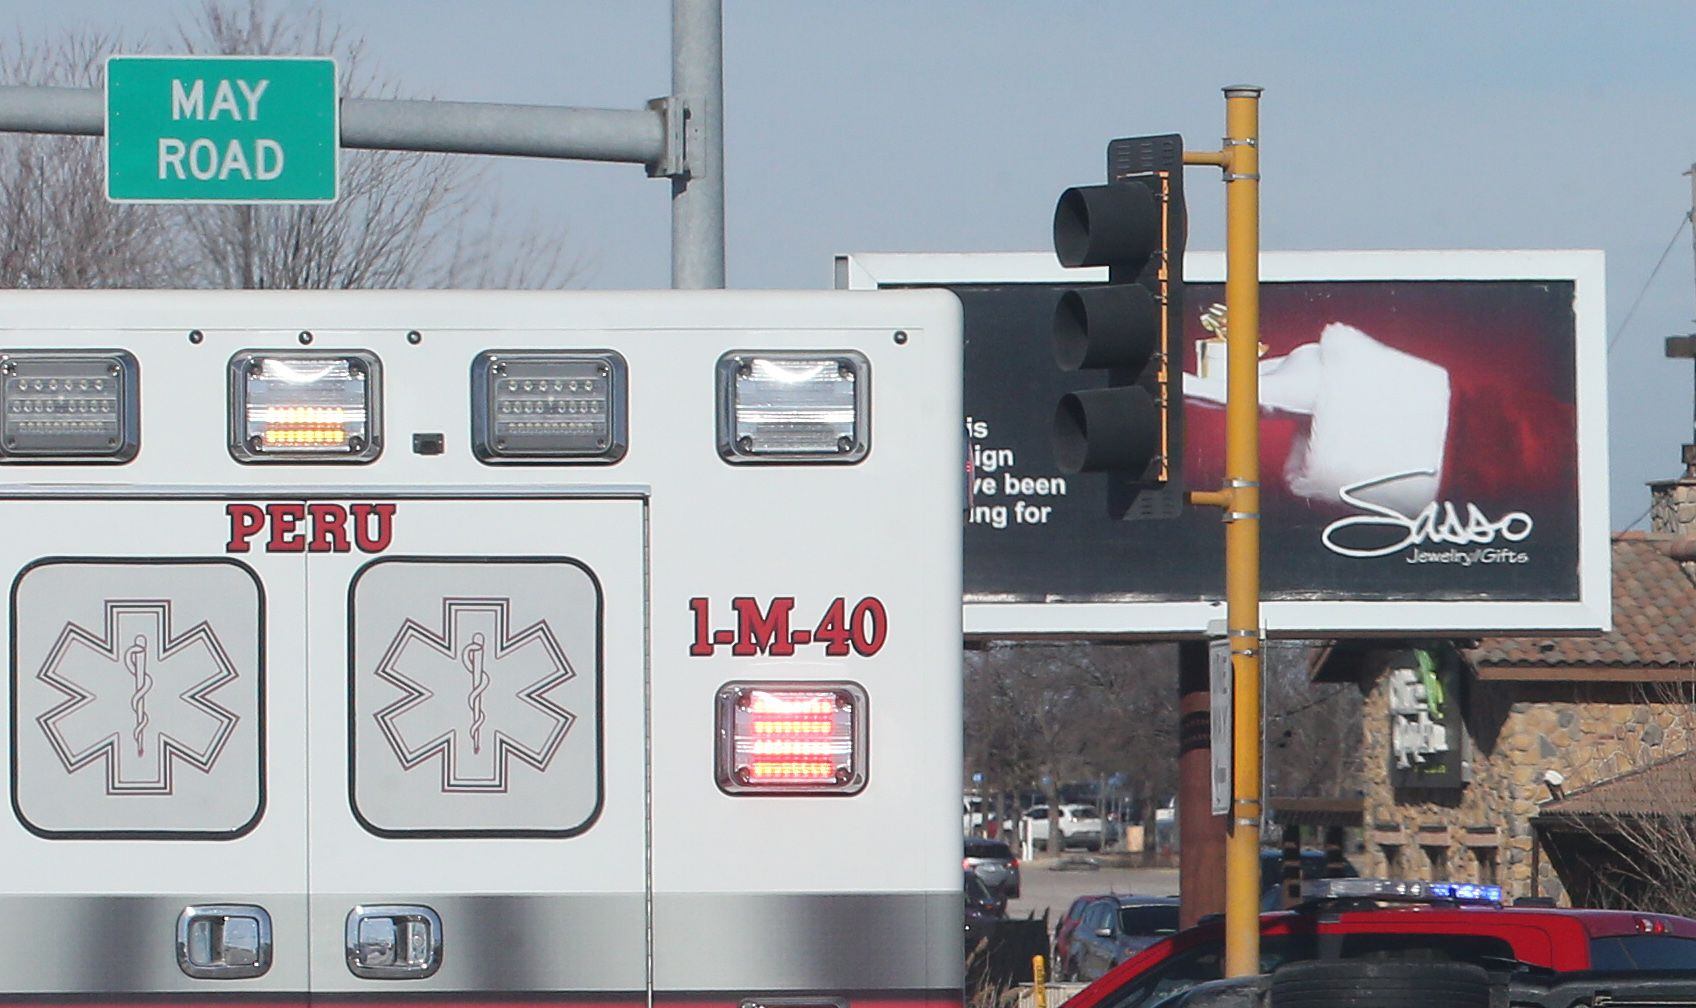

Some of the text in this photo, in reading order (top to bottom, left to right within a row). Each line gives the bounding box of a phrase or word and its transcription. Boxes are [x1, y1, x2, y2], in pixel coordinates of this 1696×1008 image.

[171, 78, 270, 121] MAY
[157, 137, 285, 181] ROAD
[1004, 472, 1066, 495] been
[225, 503, 397, 554] PERU
[1015, 500, 1052, 523] for
[688, 596, 888, 658] 1-M-40
